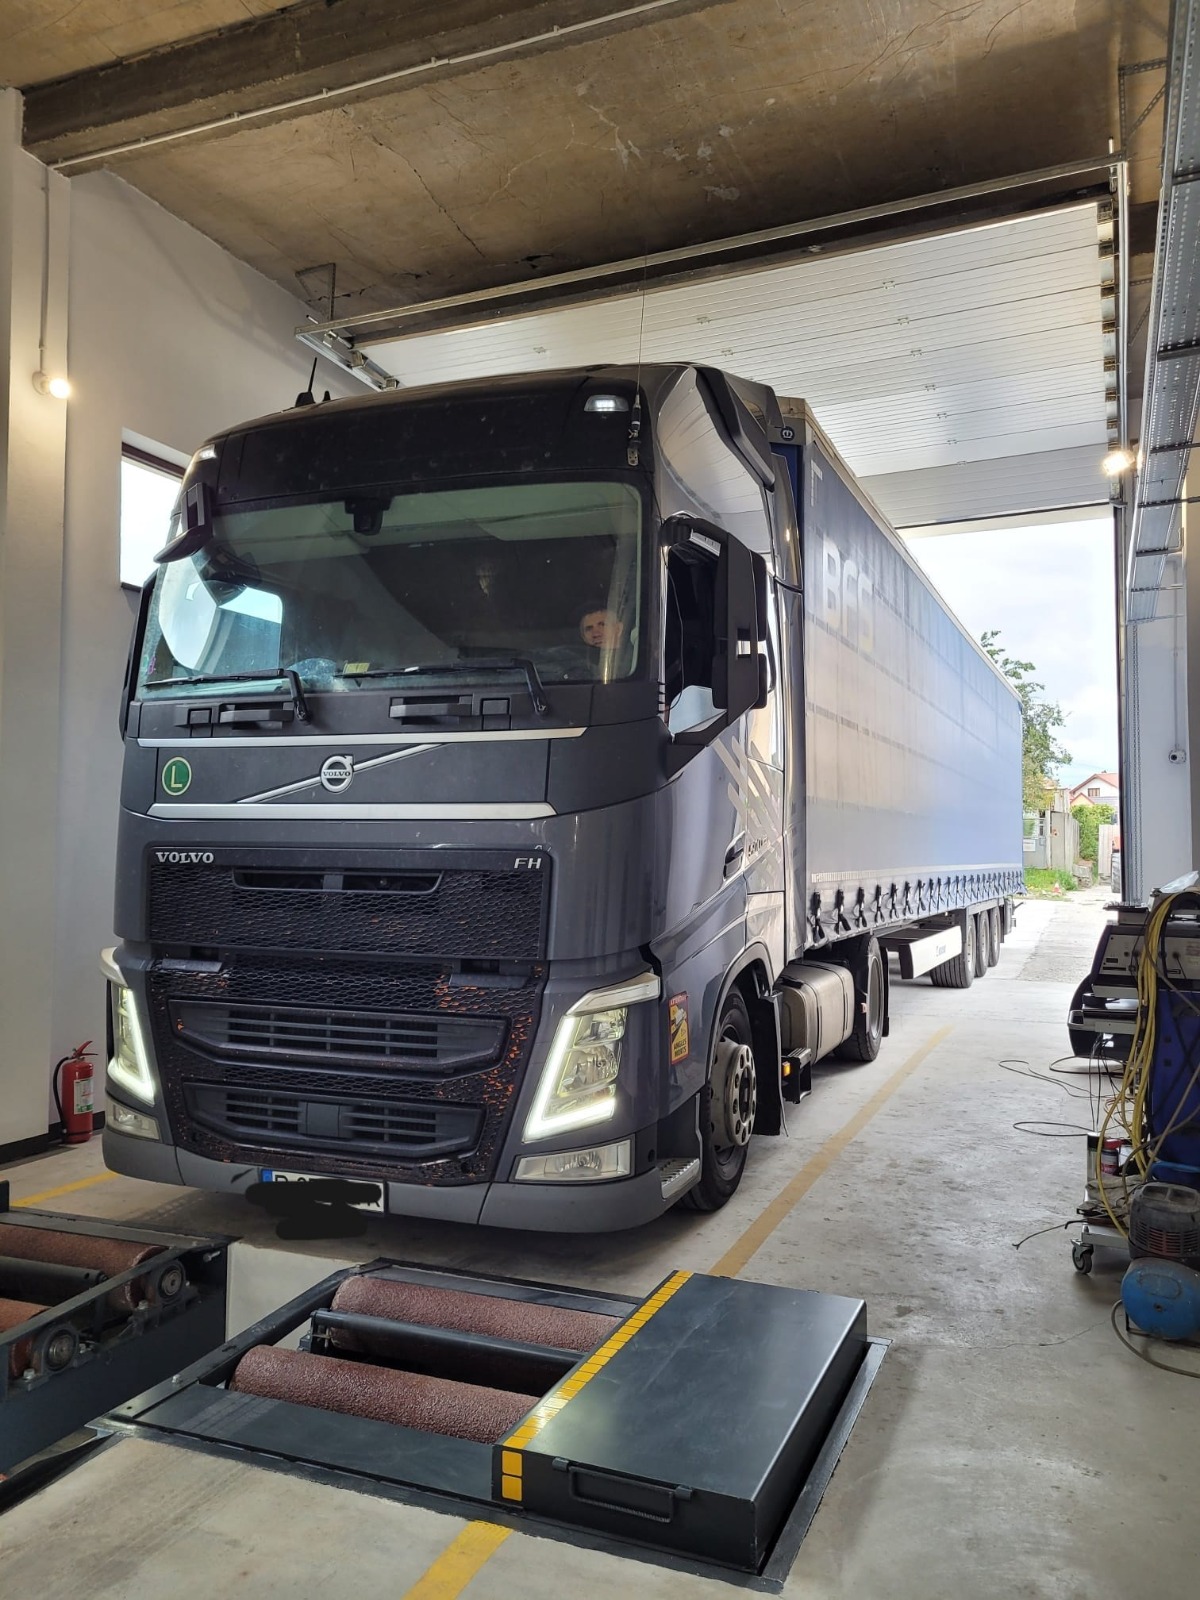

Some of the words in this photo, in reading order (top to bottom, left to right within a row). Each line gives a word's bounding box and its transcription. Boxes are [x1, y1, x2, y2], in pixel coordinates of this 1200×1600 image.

[170, 765, 183, 788] L
[155, 851, 214, 864] VOLVO
[513, 857, 542, 869] FH
